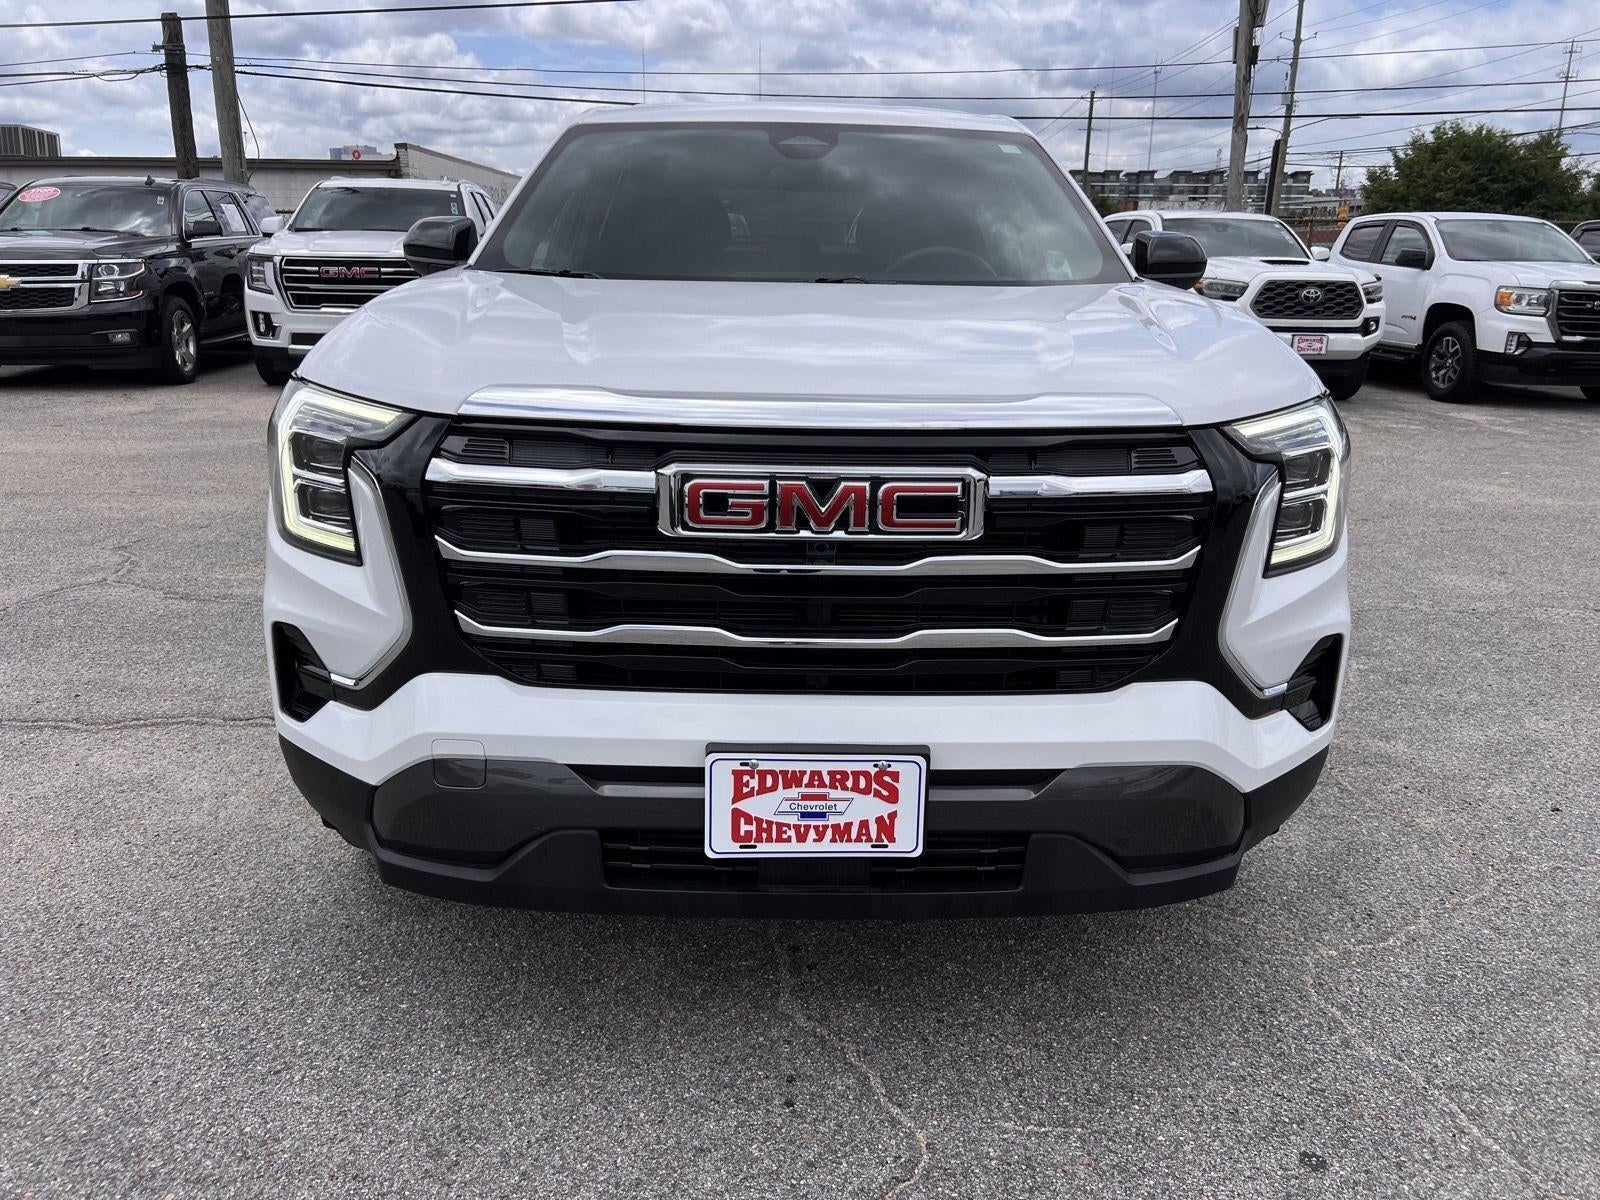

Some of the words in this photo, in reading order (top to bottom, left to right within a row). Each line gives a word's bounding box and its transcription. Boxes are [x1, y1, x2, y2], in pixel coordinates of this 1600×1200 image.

[320, 266, 379, 279] GMC
[684, 479, 963, 532] GMC
[731, 769, 900, 805] EDWARDS
[789, 802, 837, 811] Chevrolet
